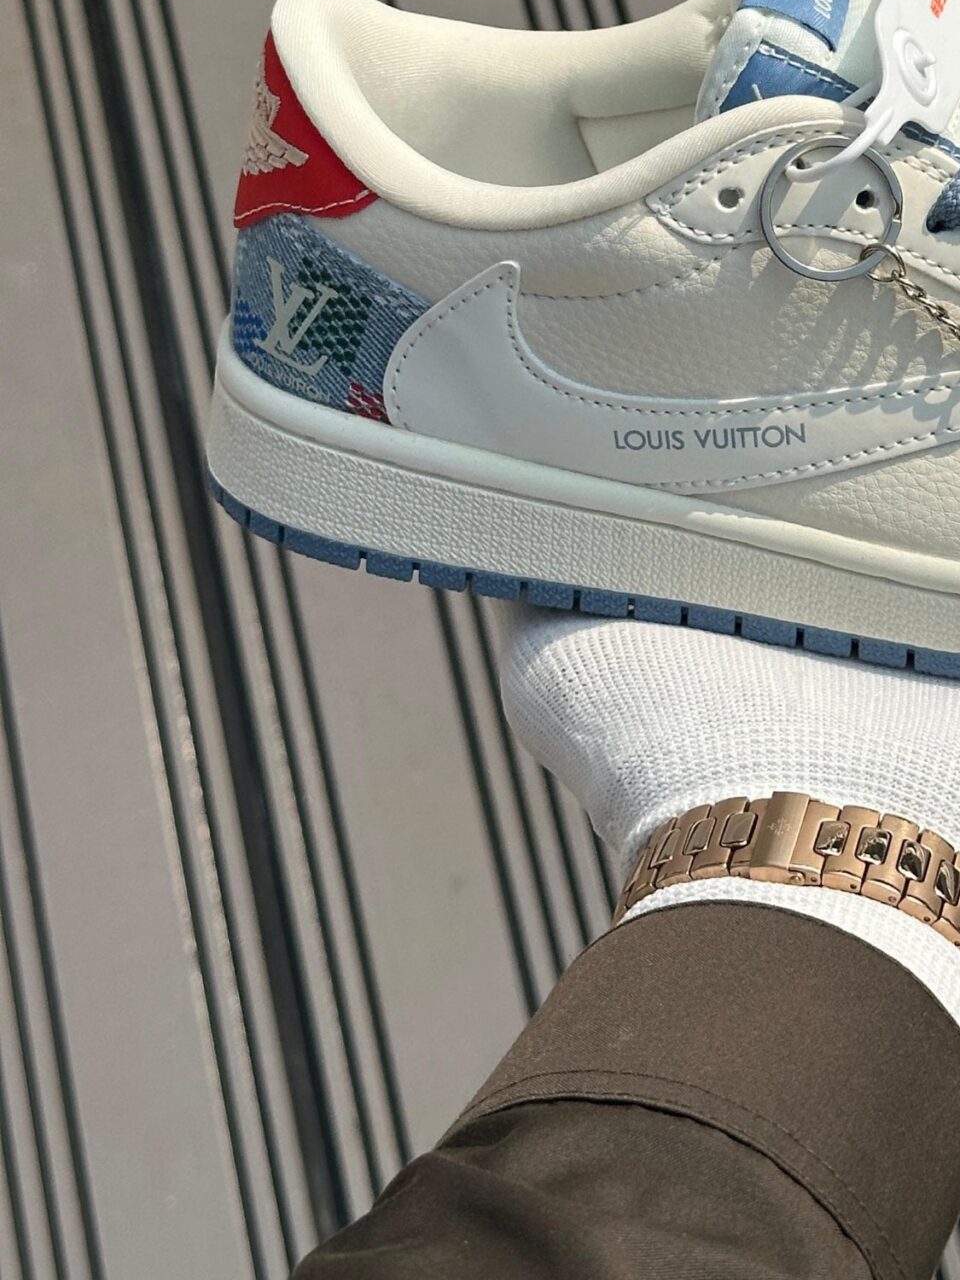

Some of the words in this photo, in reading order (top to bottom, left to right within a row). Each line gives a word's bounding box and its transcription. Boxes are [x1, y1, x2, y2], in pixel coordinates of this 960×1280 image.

[252, 255, 338, 376] LV
[613, 430, 685, 450] LOUIS
[693, 423, 806, 449] VUITTON
